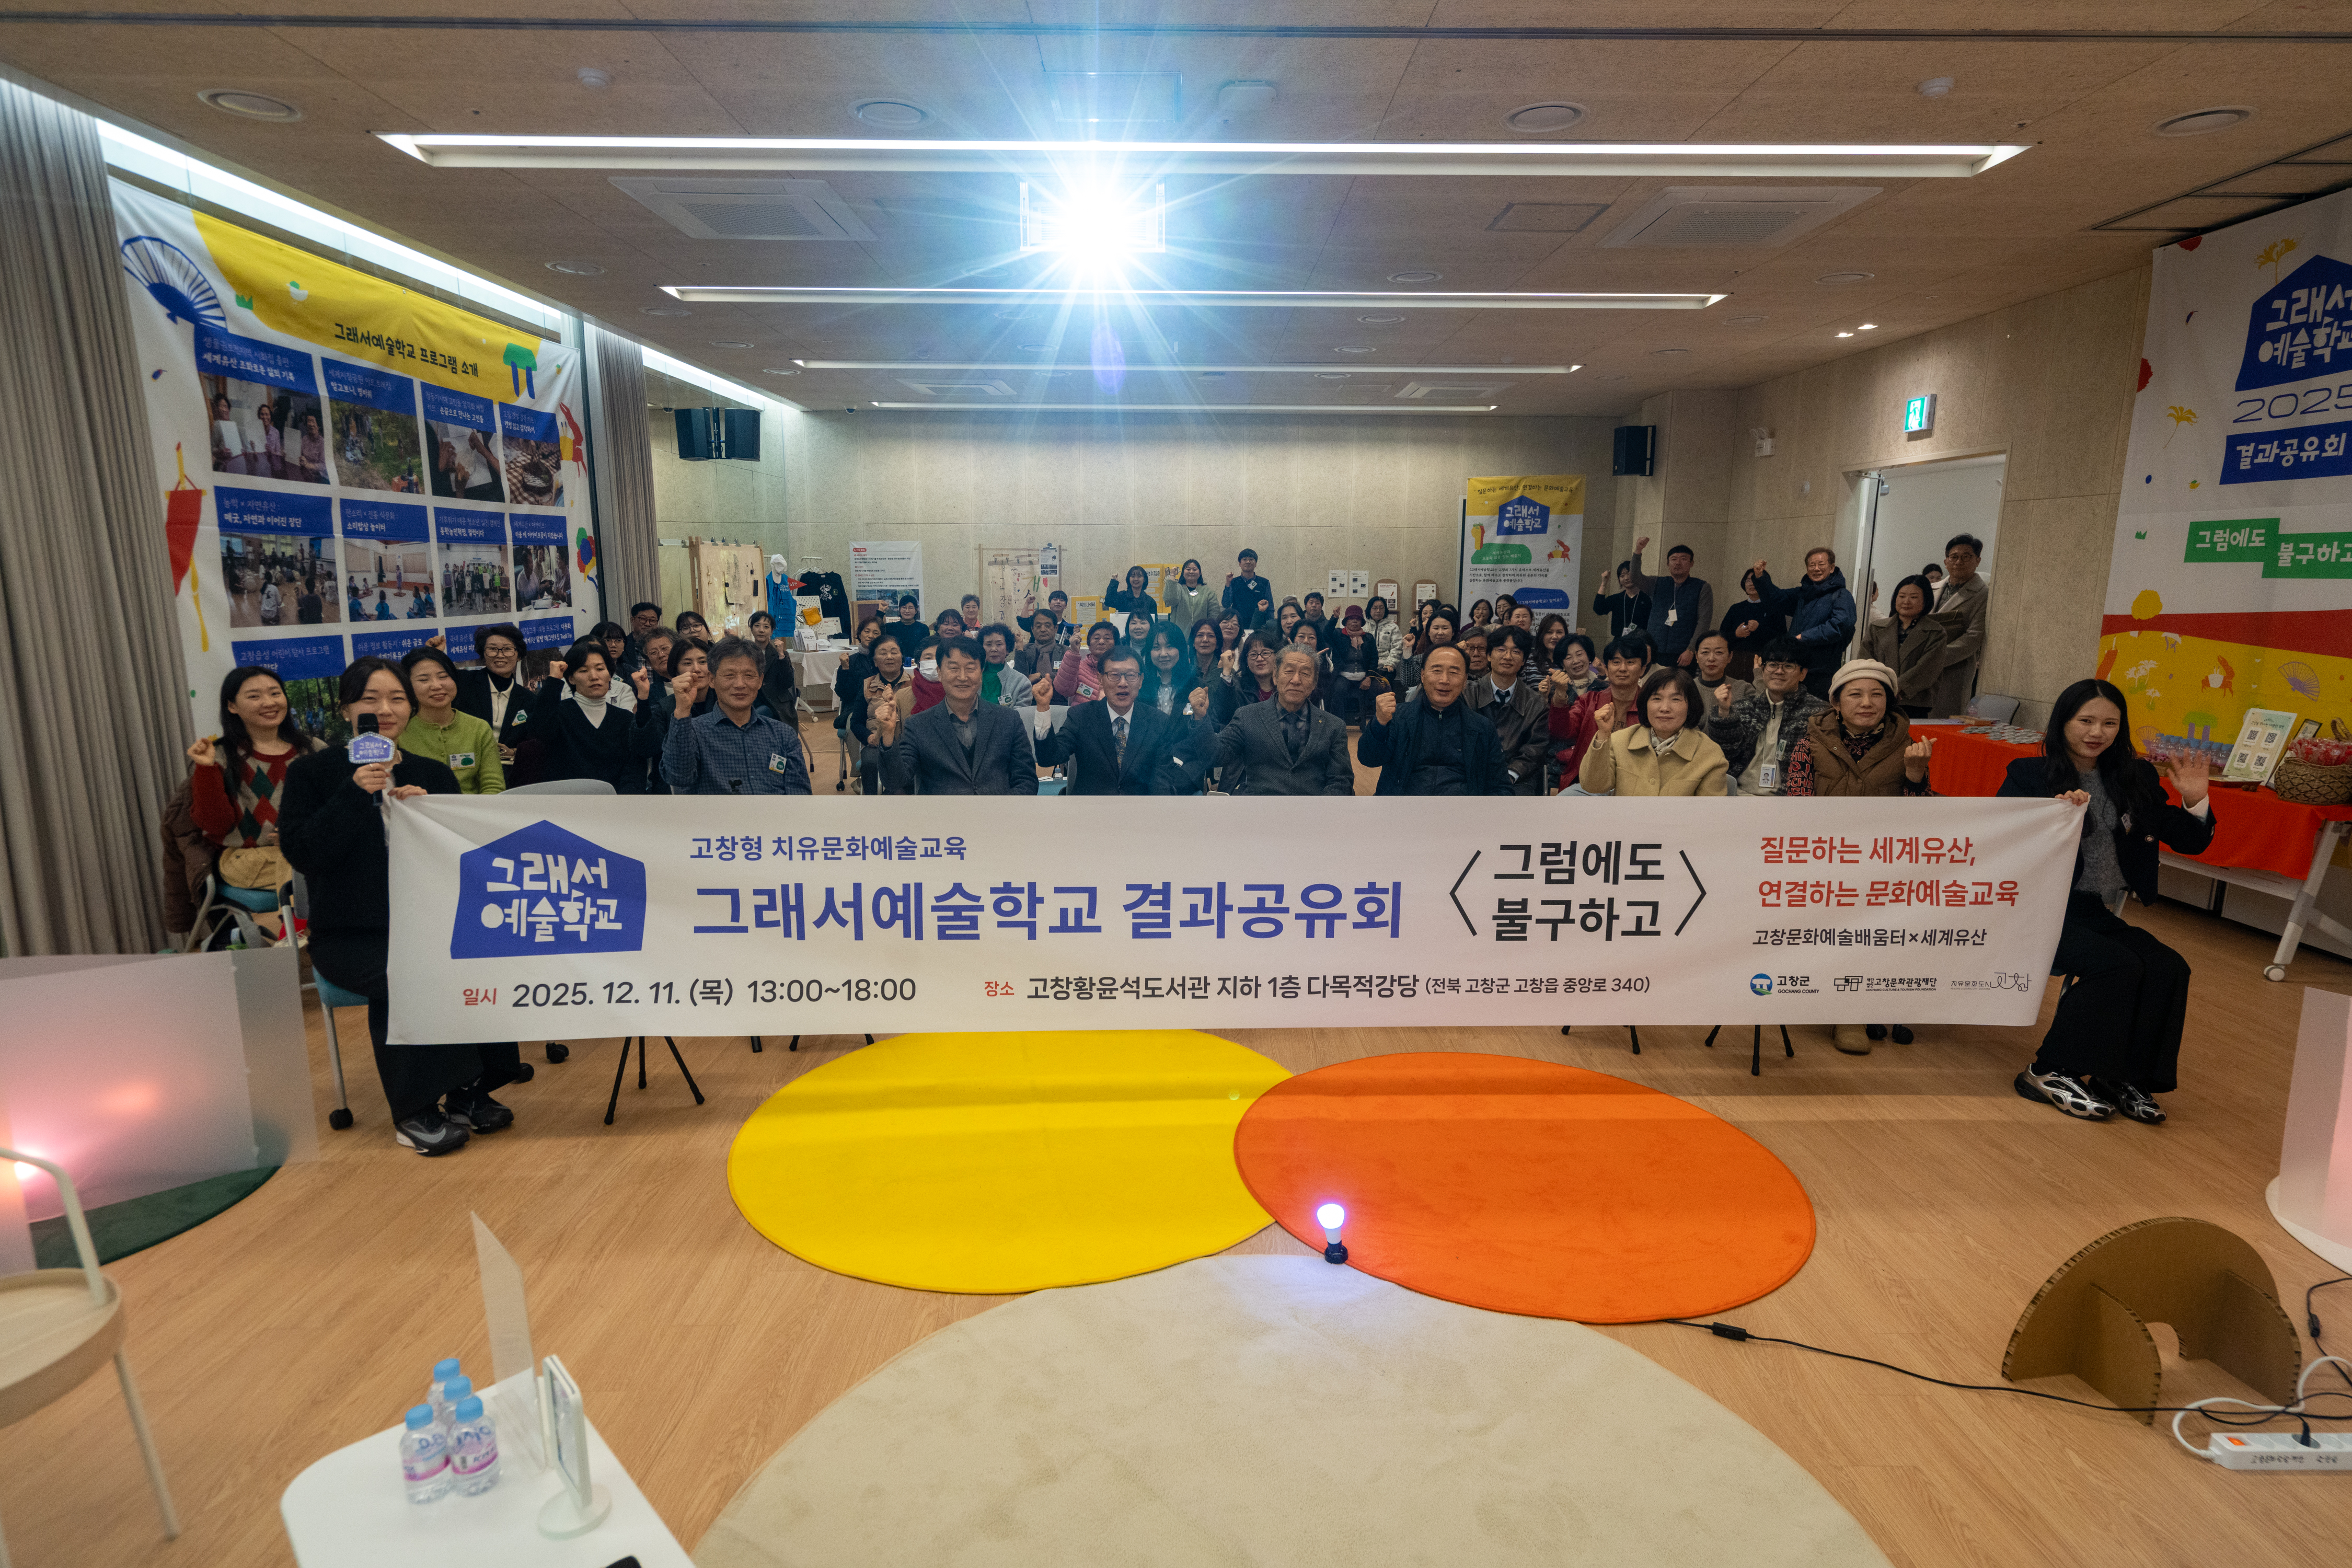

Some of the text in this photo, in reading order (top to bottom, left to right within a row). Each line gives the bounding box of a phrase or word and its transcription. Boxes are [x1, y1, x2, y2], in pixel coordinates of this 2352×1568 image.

[2266, 284, 2352, 331] 그래서
[335, 322, 478, 377] 그래서예술학교 프로그램 소개
[2258, 316, 2352, 369] 예술학교
[202, 352, 237, 369] 세계유산
[282, 371, 295, 383] 기록
[2232, 384, 2352, 424] 2025
[440, 407, 457, 417] 손끝으로
[458, 410, 471, 421] 만나는
[471, 413, 484, 424] 고인돌
[504, 420, 512, 430] 갯벌
[520, 424, 536, 434] 감각하기
[2236, 432, 2347, 470] 결과공유회
[243, 514, 266, 526] 자연과
[267, 515, 287, 527] 이어진
[288, 517, 302, 528] 장단
[345, 509, 362, 518] 판소리
[1505, 504, 1539, 518] 그래서
[347, 522, 386, 533] 소리밥상 놀이터
[440, 527, 468, 537] 동학농민혁명,
[1503, 515, 1542, 532] 예술학교
[547, 532, 563, 540] 피었습니다
[2196, 528, 2266, 552] 그럼에도
[2278, 541, 2352, 567] 불구하고
[561, 622, 571, 630] 다문화
[370, 641, 381, 651] 정보
[401, 639, 412, 648] 쉬운
[412, 638, 423, 647] 글로
[451, 644, 468, 654] 세계유산
[536, 635, 544, 643] 탐방
[240, 649, 270, 662] 고창읍성
[306, 644, 330, 655] 프로그램
[689, 835, 967, 861] 고창형 치유문화예술교육
[1760, 836, 1976, 866] 질문하는 세계유산,
[486, 851, 609, 895] 그래서
[1494, 840, 1665, 885] 그럼에도
[1758, 880, 2020, 907] 연결하는 문화예술교육
[480, 890, 623, 942] 예술학교
[694, 881, 1402, 940] 그래서예술학교 결과공유회
[1492, 897, 1662, 941] 불구하고
[984, 980, 1015, 997] 장소
[1027, 974, 1651, 1000] 고창황윤석도서관 지하 1층 다목적강당 (전북 고창군 고창읍 중앙로 340)
[1777, 976, 1810, 987] 고창군
[1874, 977, 1937, 988] 고창문화관광재단
[463, 987, 497, 1005] 일시
[512, 977, 916, 1008] 2025. 12. 11. (목) 13:00~18:00
